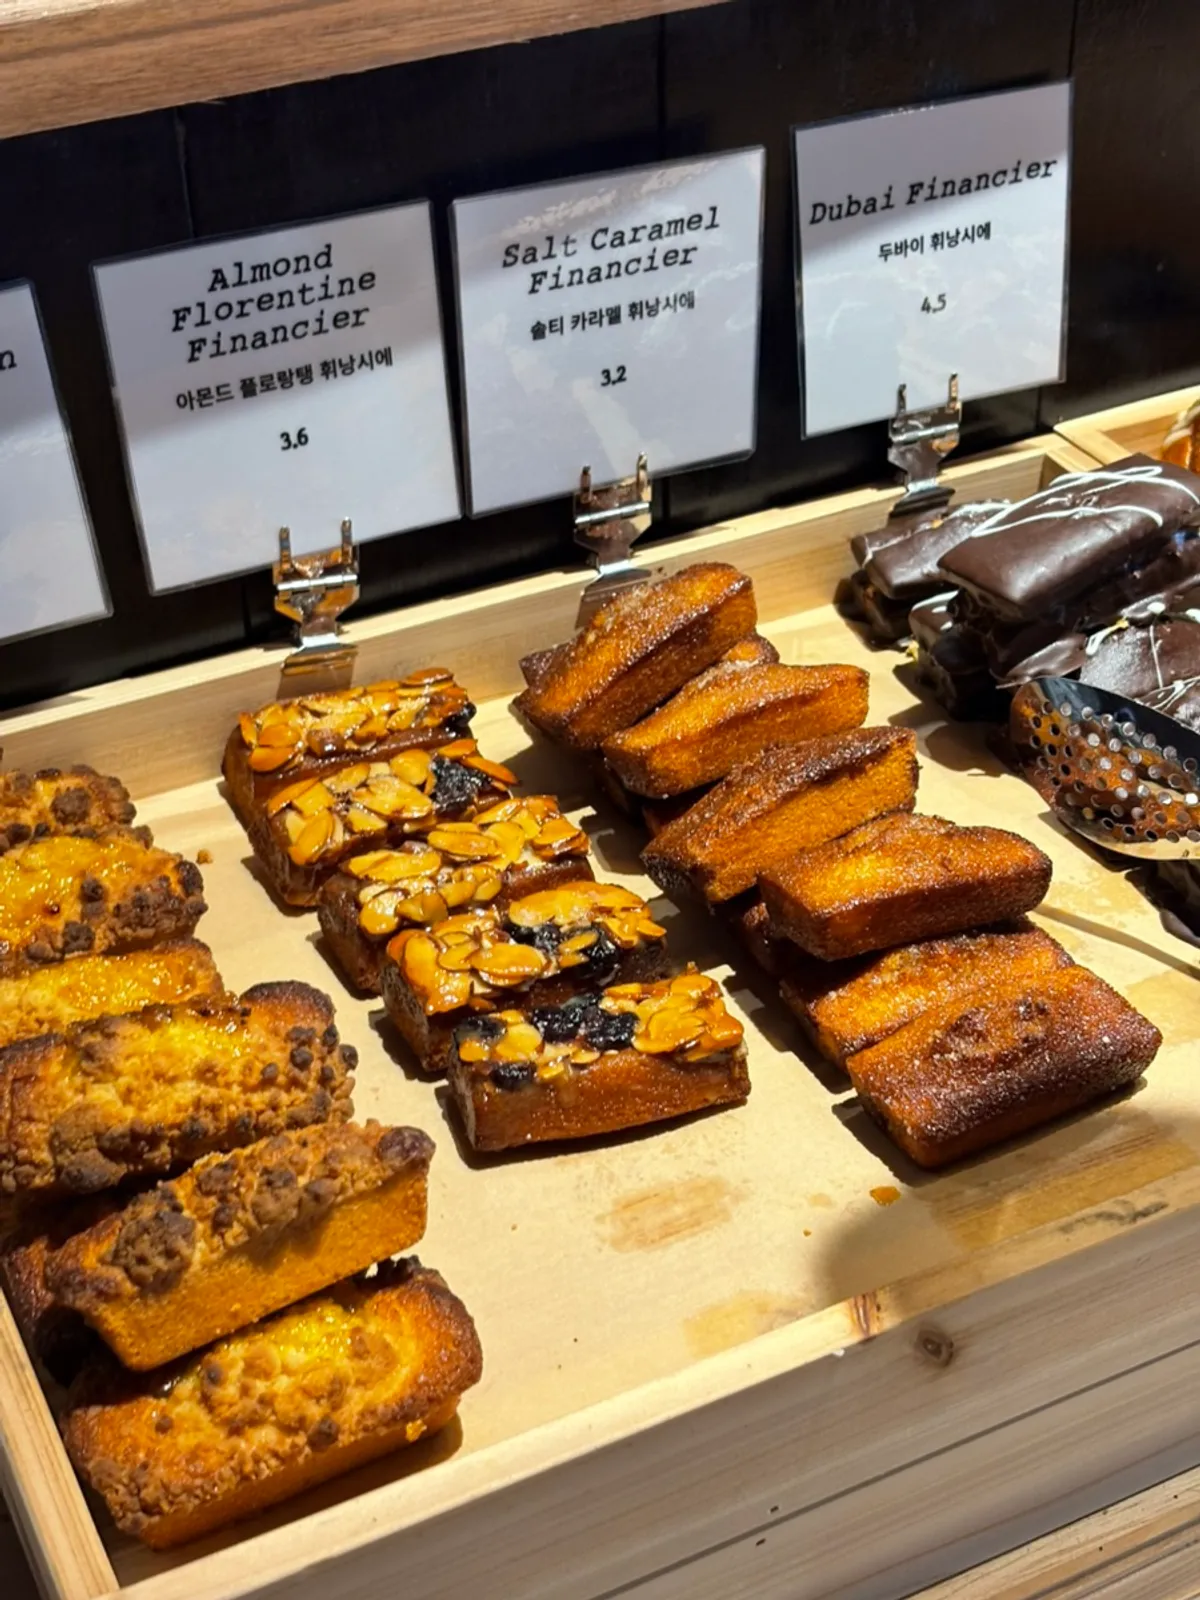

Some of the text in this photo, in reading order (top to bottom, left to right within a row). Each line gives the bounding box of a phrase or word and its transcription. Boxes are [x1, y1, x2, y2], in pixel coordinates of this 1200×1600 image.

[809, 159, 1058, 225] Dubai Financier
[502, 206, 721, 268] Salt Caramel
[878, 221, 991, 262] 두바이 휘낭시에
[207, 244, 333, 293] Almond
[528, 245, 698, 295] Financier
[172, 270, 376, 332] Florentine
[530, 290, 695, 341] 솔티 카라멜 휘낭시에
[921, 293, 947, 314] 4.5
[187, 305, 370, 363] Financier
[176, 347, 394, 411] 아몬드 플로랑탱 휘낭시에
[601, 365, 627, 387] 3.2
[280, 427, 309, 451] 3.6
